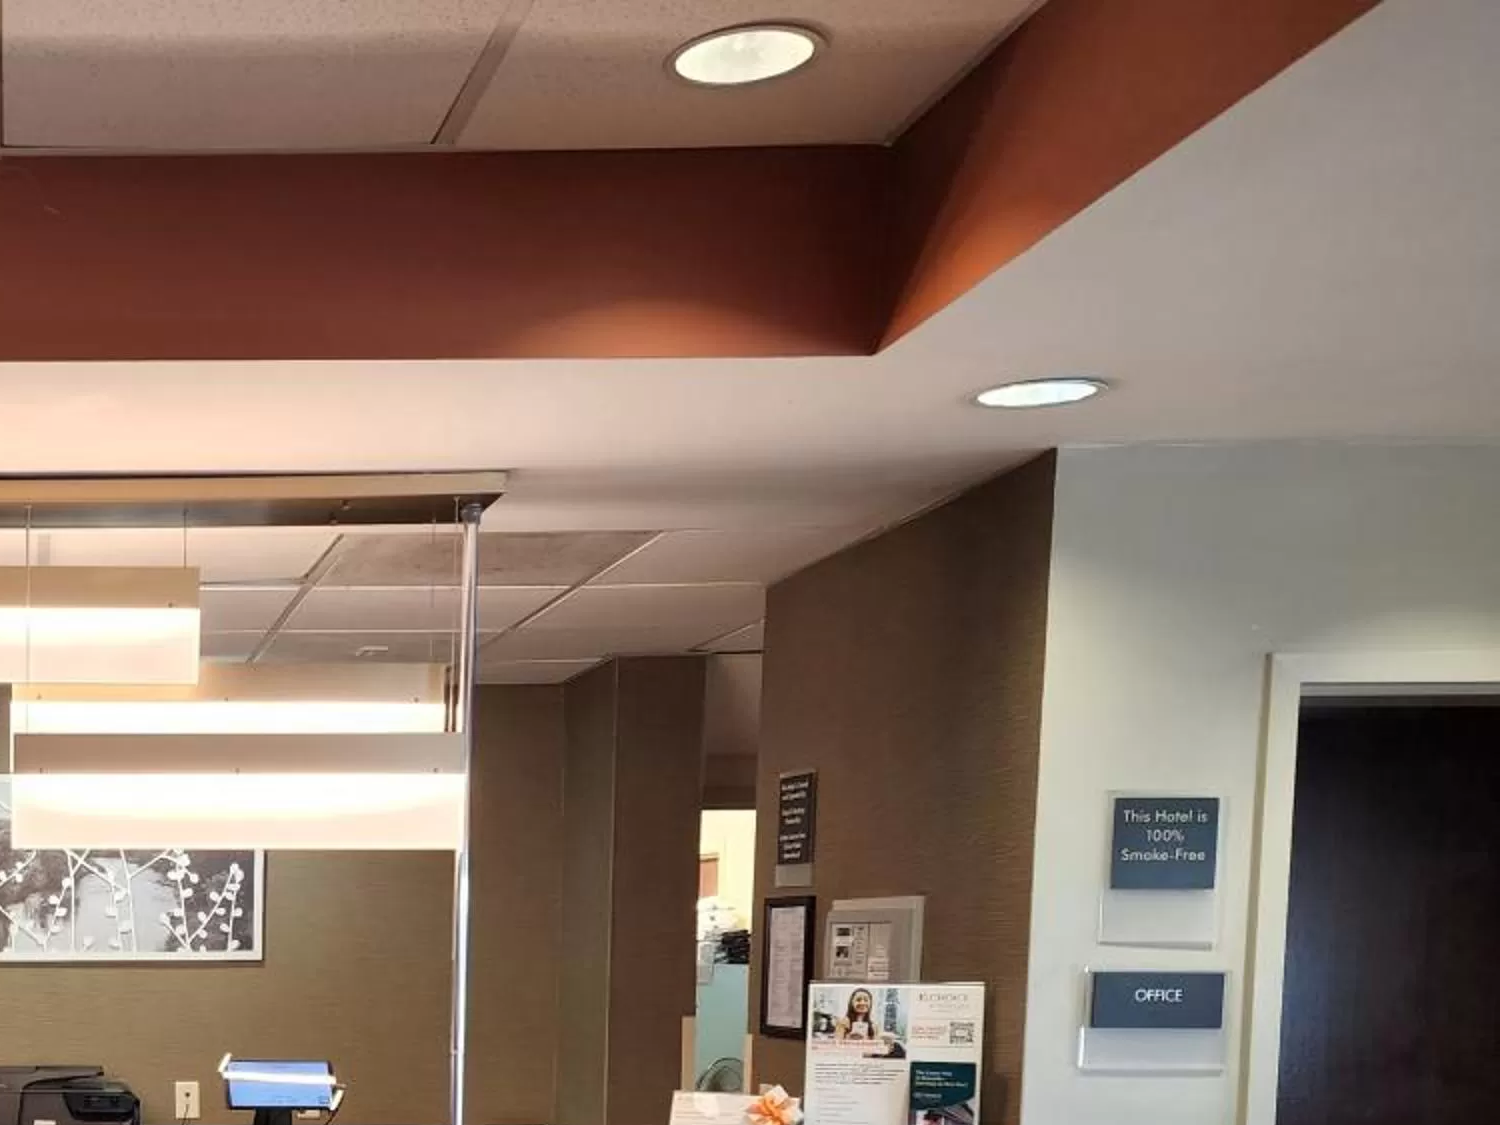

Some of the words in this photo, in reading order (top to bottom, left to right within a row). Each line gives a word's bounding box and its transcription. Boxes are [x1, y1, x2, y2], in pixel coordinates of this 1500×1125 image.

[1123, 809, 1151, 823] This
[1155, 809, 1193, 823] Hotel
[1197, 809, 1208, 823] is
[1146, 829, 1185, 841] 100%
[1120, 847, 1206, 861] Smoke-Free
[1134, 987, 1184, 1003] OFFICE
